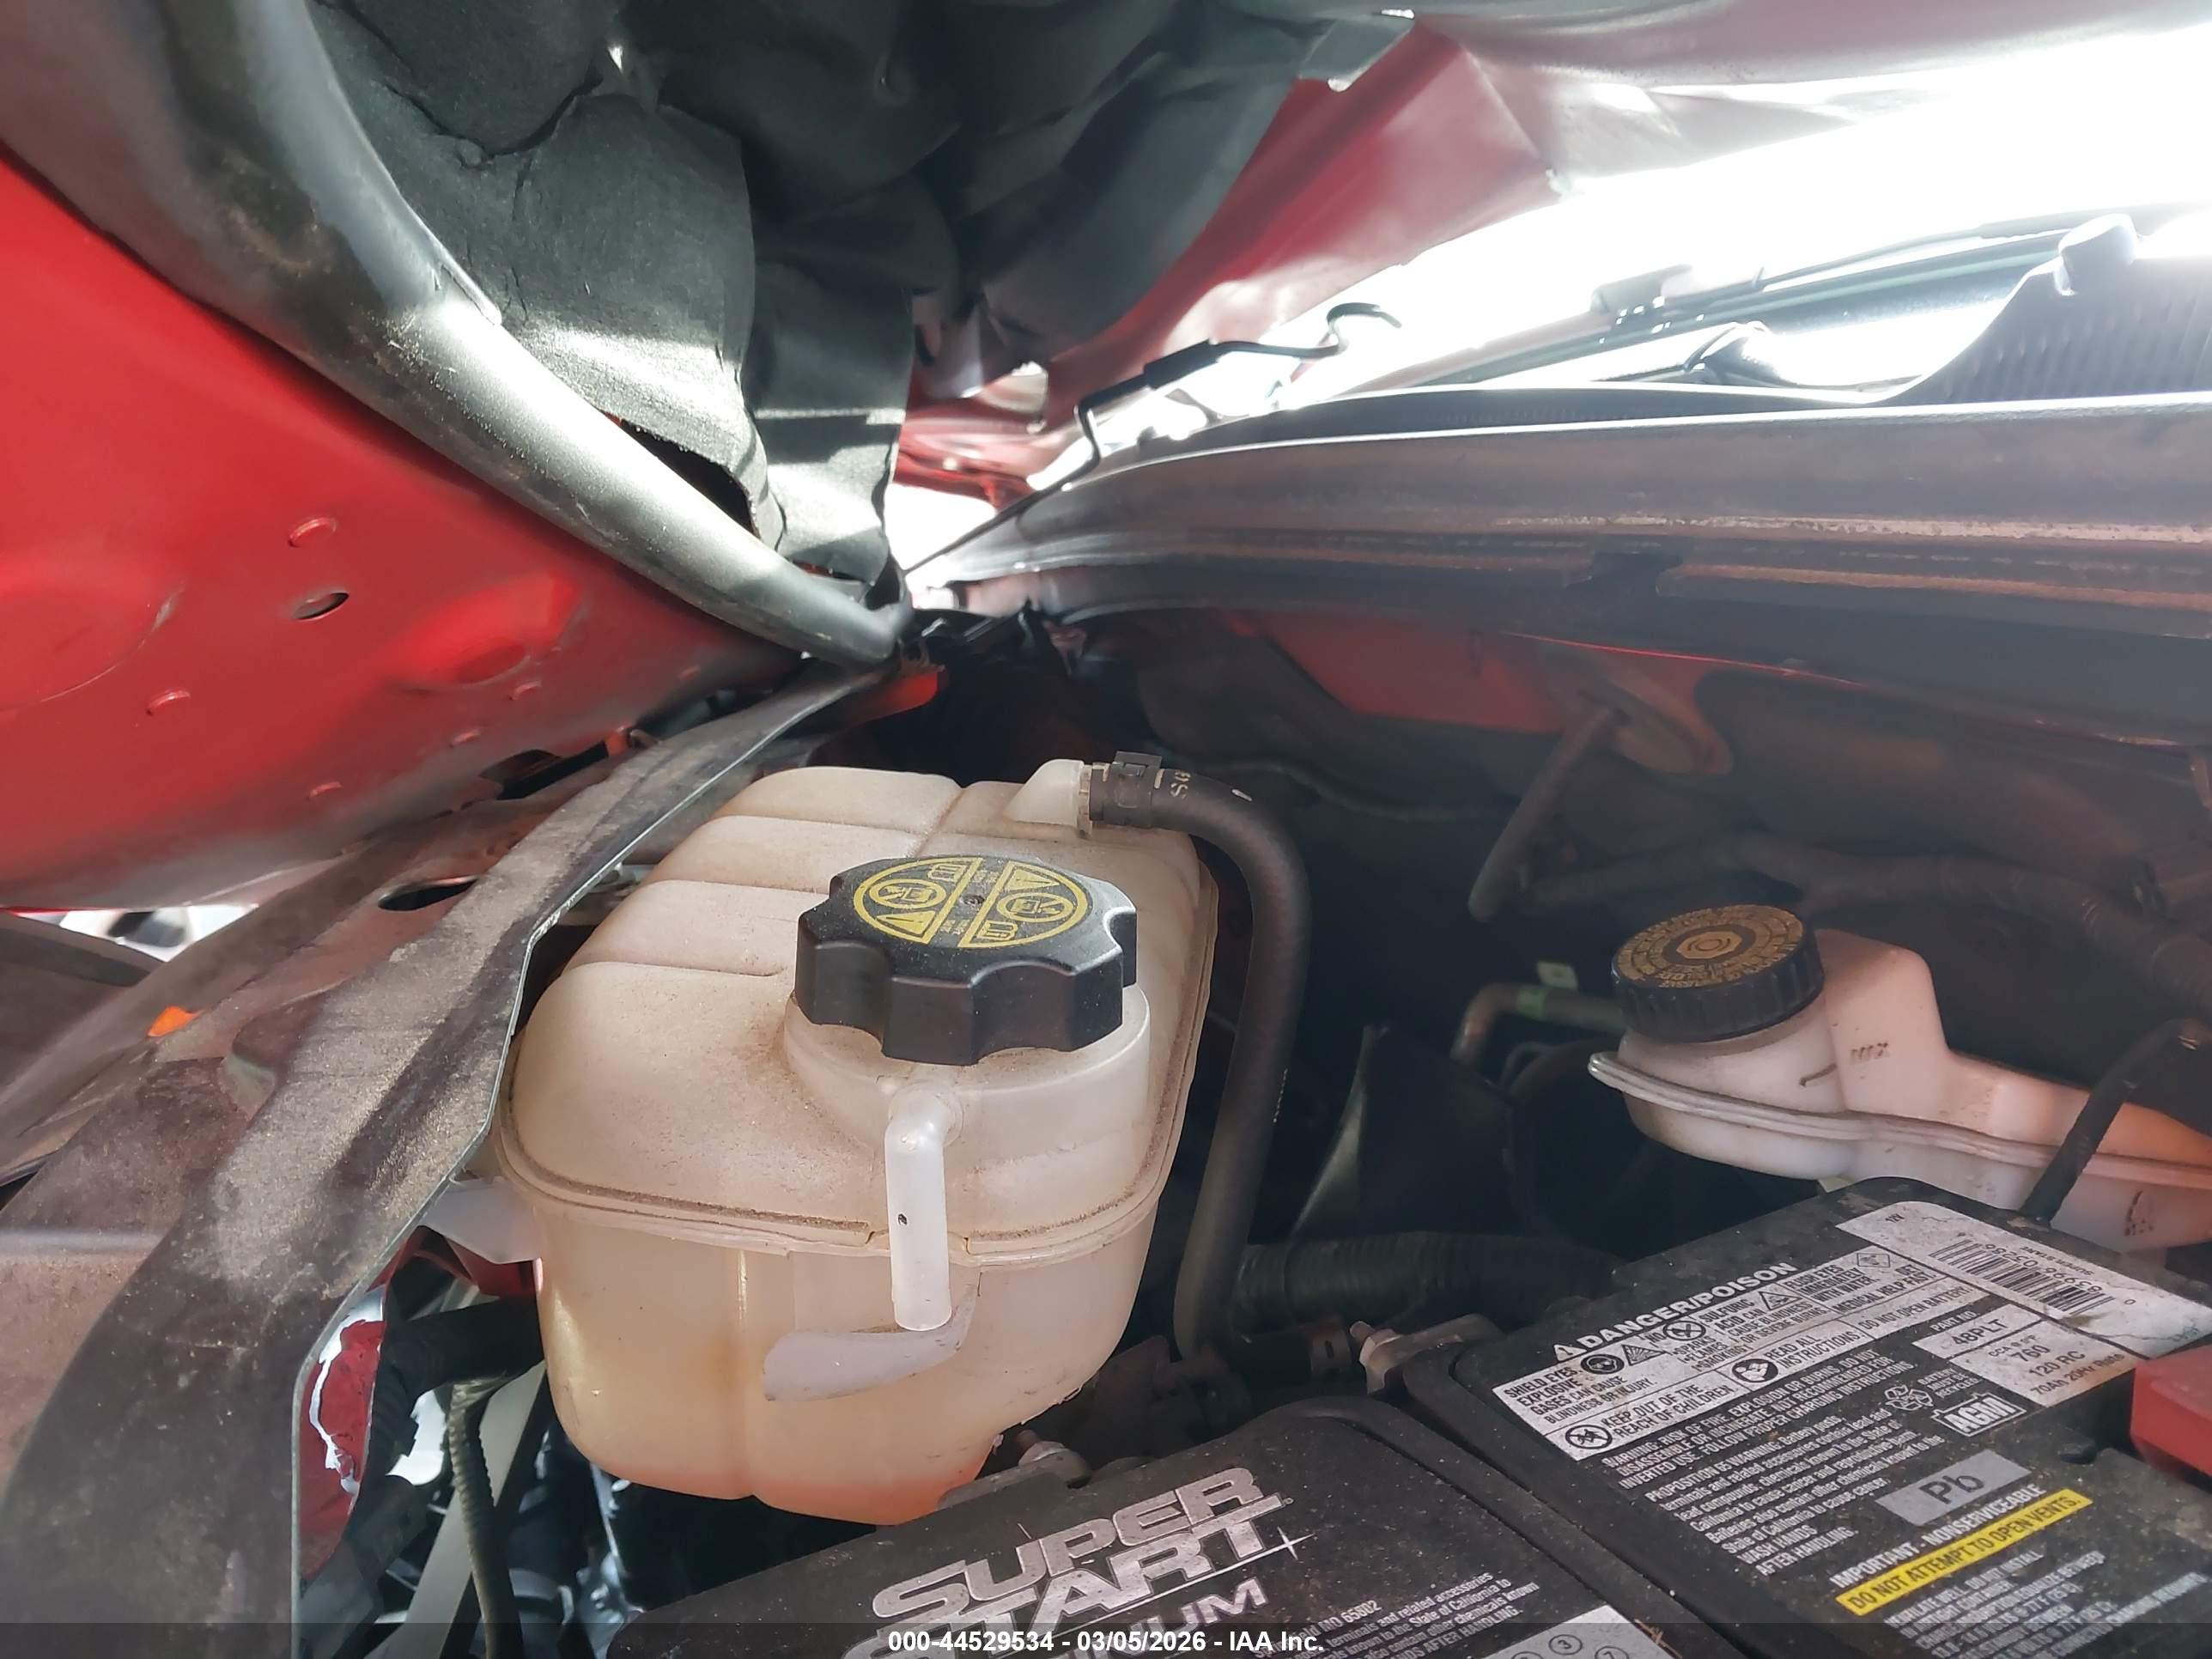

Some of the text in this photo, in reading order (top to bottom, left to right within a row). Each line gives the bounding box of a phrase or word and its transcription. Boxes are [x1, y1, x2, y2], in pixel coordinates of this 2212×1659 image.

[1783, 1263, 1844, 1290] FLUSH EYES
[1797, 1267, 1864, 1296] IMMEDIATELY
[1578, 1262, 1795, 1347] DANGER/POISON
[1810, 1286, 1844, 1302] WITH
[1832, 1291, 1884, 1313] MEDICAL
[1875, 1280, 1906, 1296] HELP
[1698, 1298, 1755, 1322] SULFURIC
[1713, 1307, 1767, 1330] ACID CAN
[1727, 1300, 1813, 1337] CAUSE BLINDNESS
[1856, 1318, 1880, 1330] DO
[1873, 1311, 1901, 1324] NOT
[1895, 1302, 1929, 1316] OPEN
[1929, 1316, 1960, 1332] PART
[1644, 1331, 1667, 1343] NO
[1739, 1333, 1760, 1344] OR
[1762, 1334, 1822, 1360] READ ALL
[1951, 1318, 2007, 1345] 48PLT
[2008, 1344, 2051, 1362] 760
[2027, 1350, 2086, 1376] 120 RC
[1503, 1377, 1548, 1398] SHIELD
[1516, 1376, 1583, 1407] EXPLOSIVE
[1917, 1367, 1956, 1385] BATTERY
[1926, 1376, 1955, 1391] MUST
[2029, 1378, 2069, 1395] 70Ah
[2063, 1364, 2096, 1382] 20Hr
[1529, 1375, 1627, 1415] GASES CAN CAUSE
[1543, 1397, 1603, 1424] BLINDNESS
[1598, 1390, 1620, 1402] OR
[1600, 1383, 1704, 1428] KEEP OUT OF THE
[1656, 1429, 1688, 1445] RISK
[1684, 1422, 1703, 1434] OF
[1728, 1387, 1790, 1416] EXPLOSION
[1784, 1379, 1806, 1391] OR
[1838, 1357, 1859, 1368] DO
[1853, 1348, 1880, 1362] NOT
[1613, 1415, 1659, 1437] REACH
[1652, 1407, 1674, 1421] OF
[1615, 1439, 1694, 1476] DISASSEMBLE
[1689, 1432, 1712, 1445] OR
[1770, 1396, 1797, 1412] NOT
[1791, 1364, 1872, 1401] RECOMMENDED
[1944, 1395, 2016, 1432] AGM
[1618, 1461, 1676, 1489] INVERTED
[1698, 1431, 1747, 1455] FOLLOW
[1742, 1413, 1791, 1437] PROPER
[1785, 1390, 1843, 1419] CHARGING
[1644, 1466, 1719, 1502] PROPOSITION
[1713, 1460, 1732, 1472] 65
[1777, 1425, 1818, 1445] Battery
[1659, 1407, 1893, 1510] terminals and related accessories contain lead and
[1673, 1419, 1903, 1522] lead chemicals known to the State of
[1689, 1441, 1893, 1532] California to cause cancer and reproductive
[1705, 1434, 1945, 1543] Batteries also contain other chemicals known to the
[1918, 1474, 1984, 1504] Pb
[1721, 1491, 1856, 1553] State of California to cause
[1829, 1484, 2045, 1588] IMPORTANT NONSERVICEABLE
[872, 1468, 1265, 1619] SUPER
[1736, 1524, 1817, 1564] WASH HANDS
[1846, 1496, 2081, 1609] DO NOT ATTEMPT TO OPEN VENTS.
[1755, 1552, 1798, 1576] AFTER
[1434, 1572, 1494, 1603] accessories
[1340, 1600, 1382, 1624] 65802
